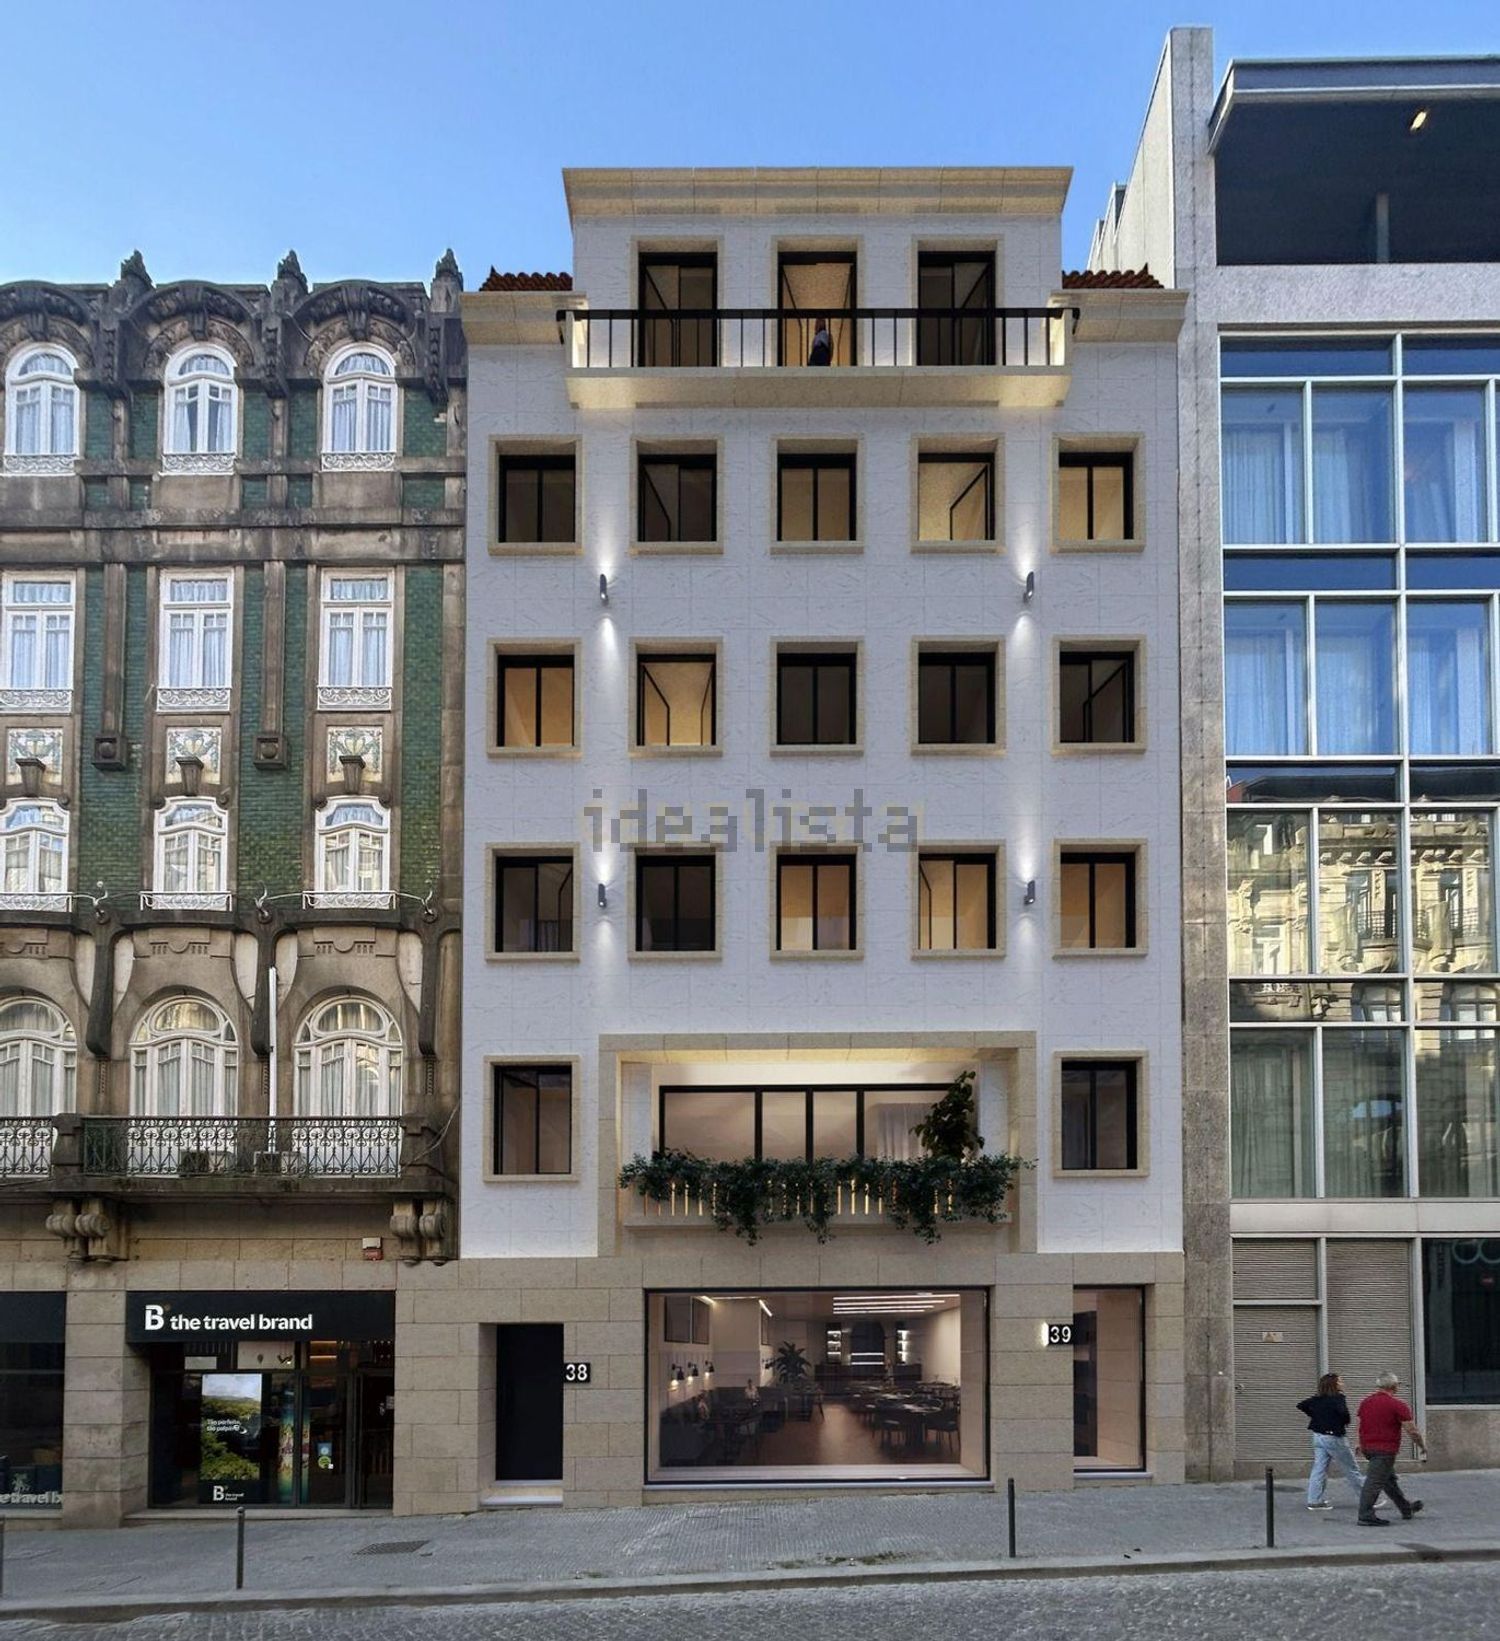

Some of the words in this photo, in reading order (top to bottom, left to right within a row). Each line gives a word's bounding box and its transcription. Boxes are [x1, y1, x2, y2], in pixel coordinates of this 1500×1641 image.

[145, 1305, 164, 1331] B
[170, 1314, 201, 1331] the
[203, 1314, 255, 1331] travel
[258, 1314, 313, 1331] brand
[1050, 1326, 1072, 1343] 39
[565, 1364, 588, 1381] 38
[213, 1485, 224, 1501] B
